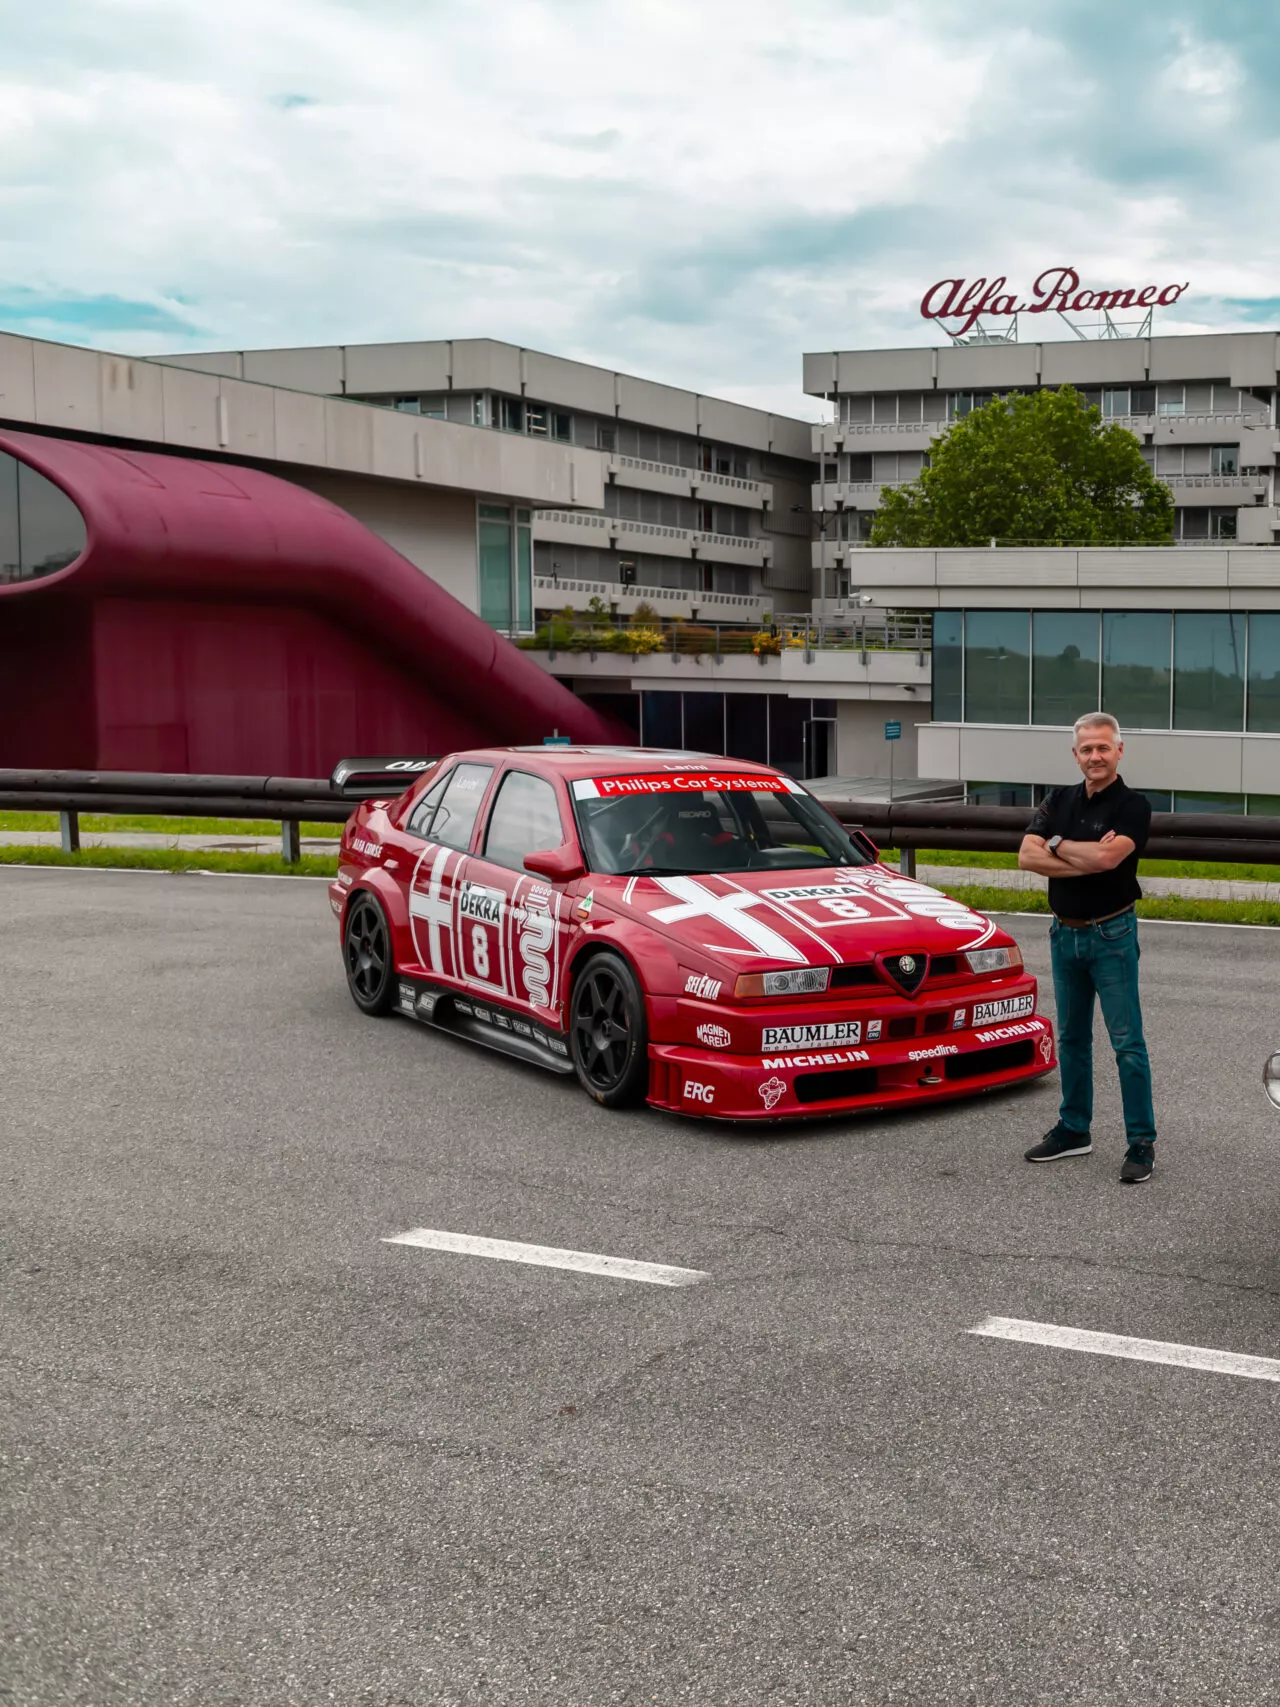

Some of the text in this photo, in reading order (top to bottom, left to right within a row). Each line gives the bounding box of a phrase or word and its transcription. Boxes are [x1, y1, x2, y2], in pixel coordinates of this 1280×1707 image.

[920, 267, 1189, 336] Alfa Romeo
[336, 769, 346, 784] 8
[602, 777, 780, 792] Philips Car Systems
[352, 838, 383, 858] ALFA CORSE
[768, 886, 864, 899] DEKRA
[461, 892, 501, 923] DEKRA
[817, 898, 871, 918] 8
[472, 924, 490, 978] 8
[975, 995, 1033, 1020] BÄUMLER
[765, 1022, 859, 1045] BÄUMLER
[975, 1020, 1045, 1043] MICHELIN
[761, 1050, 870, 1070] MICHELIN
[908, 1044, 959, 1062] speedline
[683, 1080, 716, 1103] ERG
